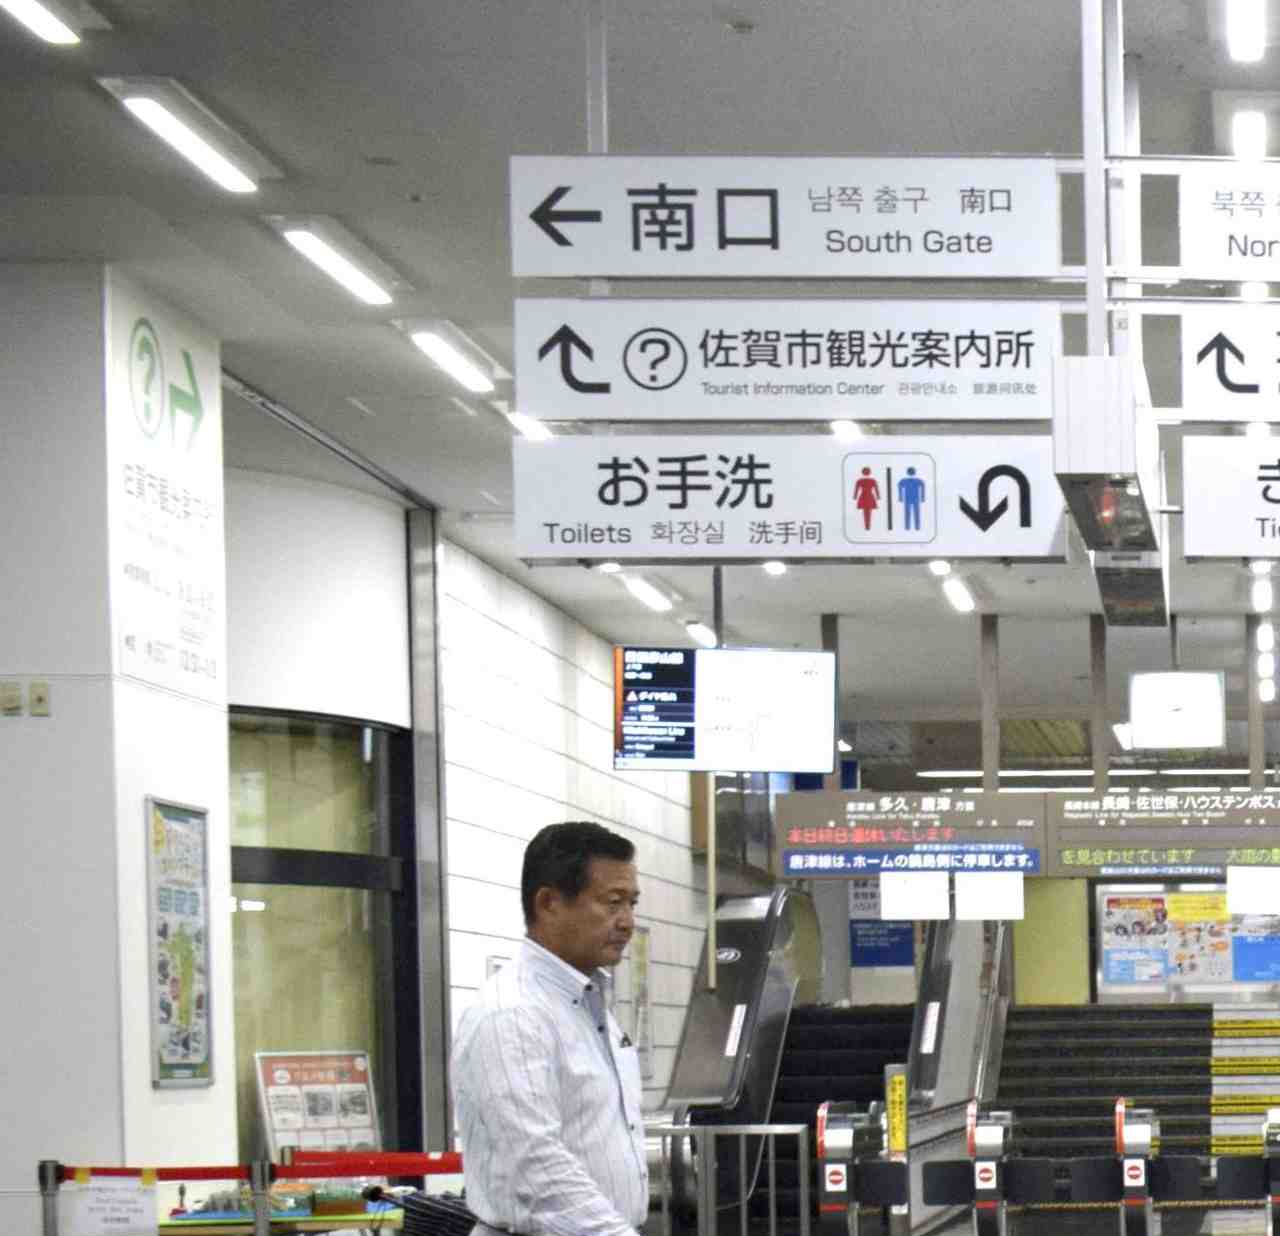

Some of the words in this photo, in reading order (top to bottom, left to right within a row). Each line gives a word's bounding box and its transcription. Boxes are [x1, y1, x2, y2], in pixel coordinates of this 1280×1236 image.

[808, 186, 864, 214] 남쪽
[873, 186, 929, 214] 출구
[959, 187, 1012, 213] 南口
[1212, 190, 1265, 219] 북쪽
[627, 183, 779, 251] 南口
[826, 229, 911, 253] South
[923, 229, 993, 253] Gate
[699, 329, 1033, 369] 佐賀市観光案内所
[701, 382, 749, 395] Tourist
[753, 382, 832, 395] Information
[837, 382, 885, 395] Center
[597, 454, 773, 509] お手洗
[544, 522, 631, 543] Toilets
[651, 521, 724, 545] 화장실
[749, 520, 822, 544] 洗手间
